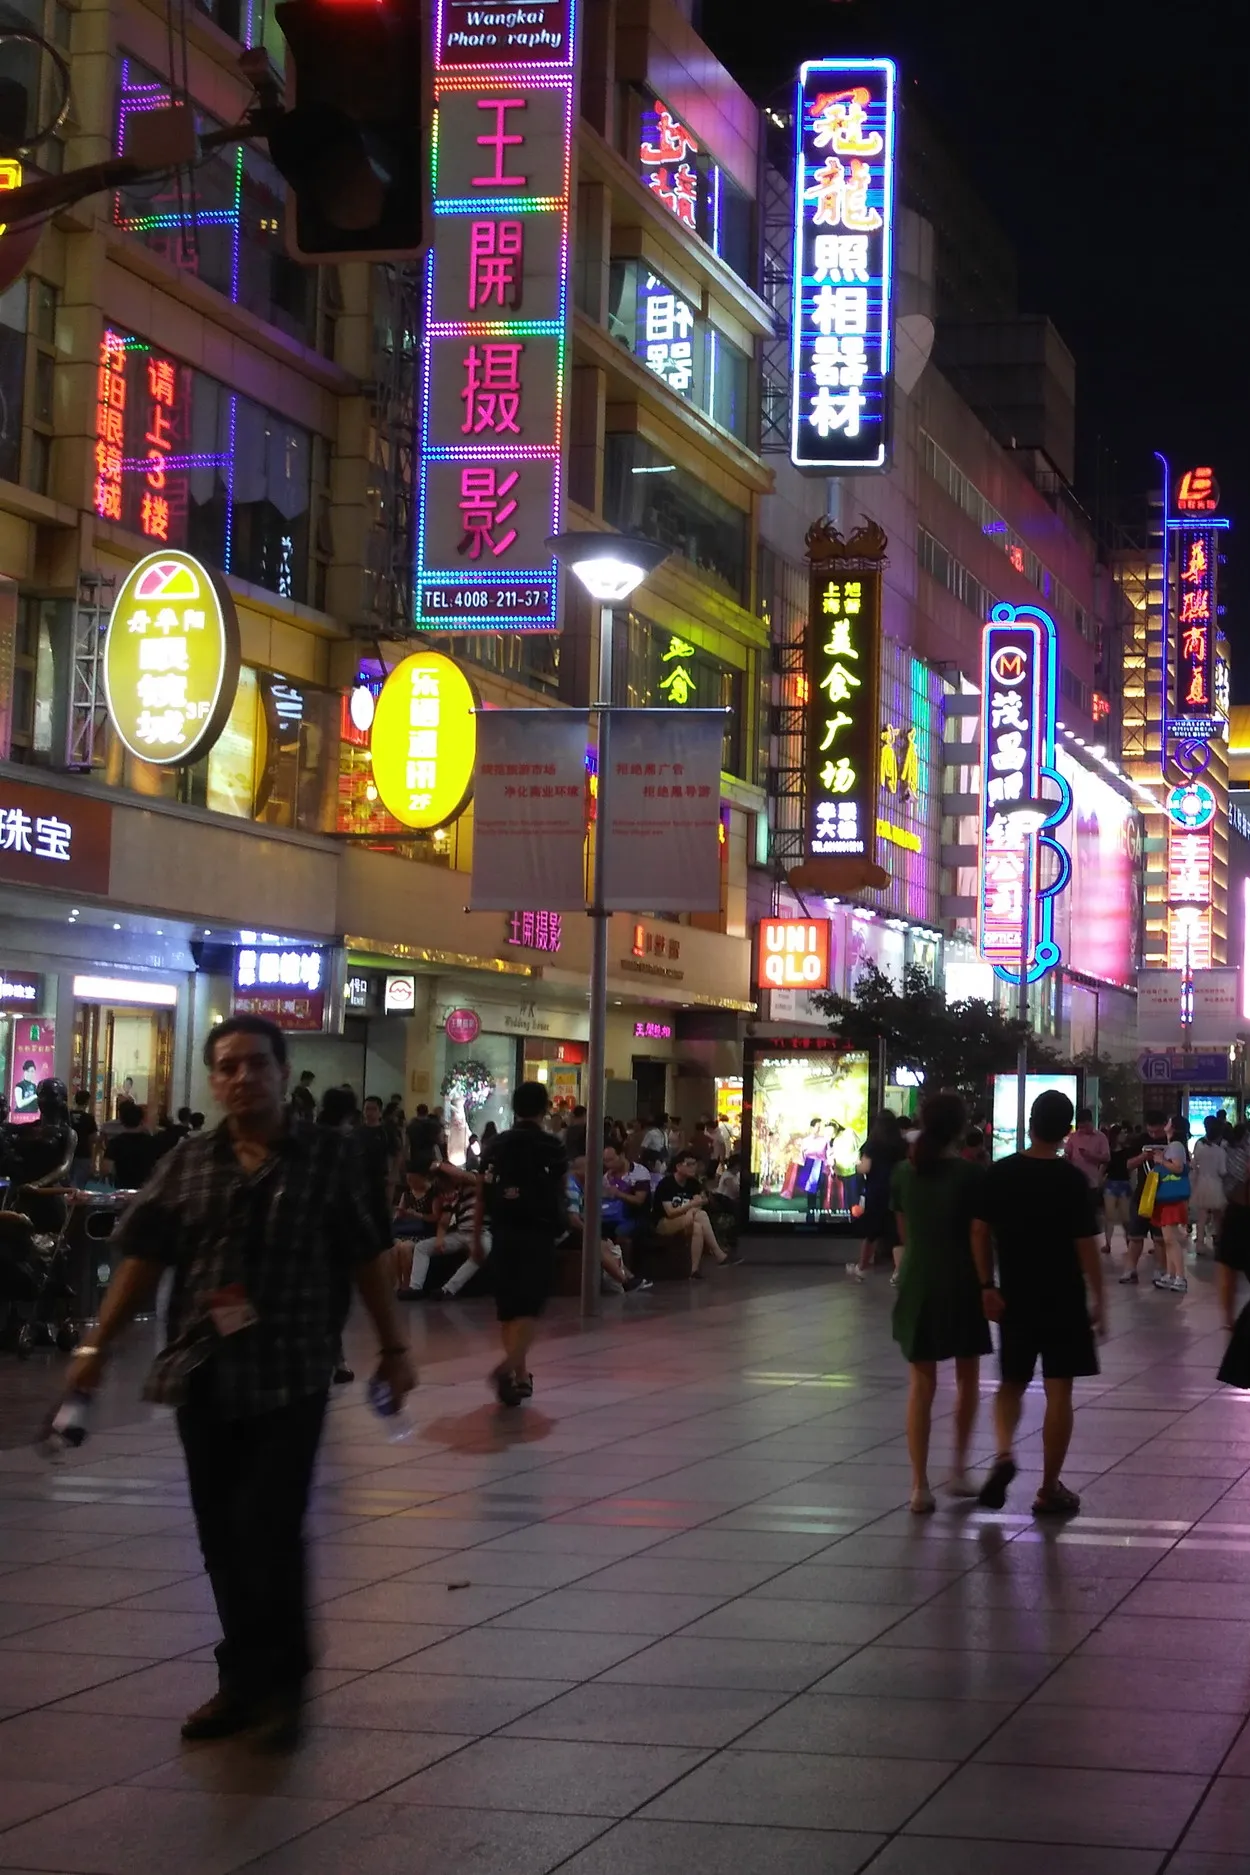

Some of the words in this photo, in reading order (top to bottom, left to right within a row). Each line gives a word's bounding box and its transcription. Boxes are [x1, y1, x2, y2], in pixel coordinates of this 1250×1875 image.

[466, 8, 545, 29] Wangkai
[447, 30, 562, 48] Photoraphy
[185, 701, 211, 719] 3F
[819, 618, 862, 793] 美食广场
[616, 763, 685, 776] 拒绝黑广告
[765, 925, 817, 952] UNI
[984, 931, 1022, 946] OPTICA
[765, 954, 822, 985] QLO
